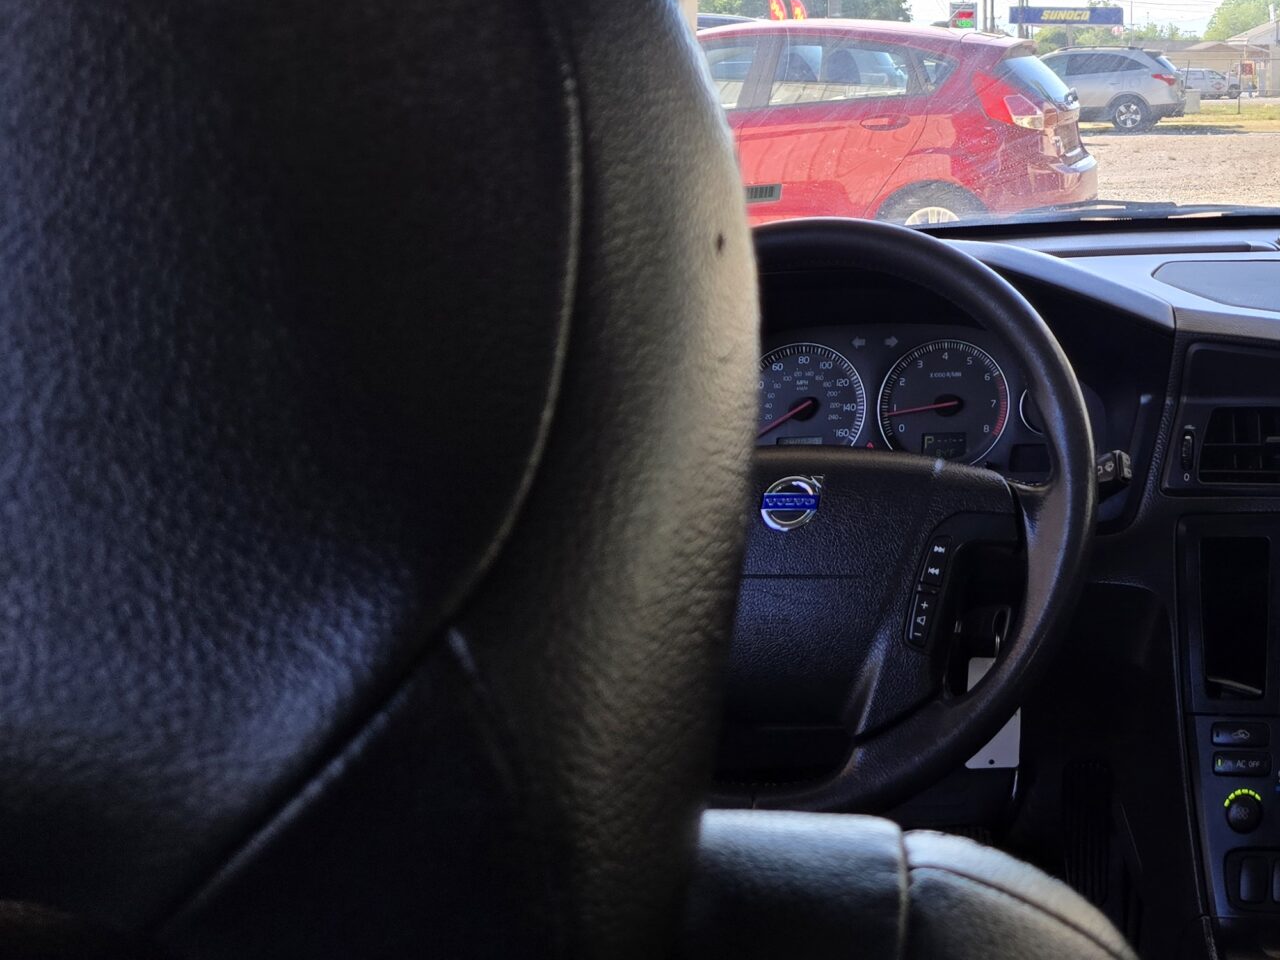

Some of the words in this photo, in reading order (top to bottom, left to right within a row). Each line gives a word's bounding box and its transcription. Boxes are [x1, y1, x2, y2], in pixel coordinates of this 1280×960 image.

[1040, 10, 1089, 20] SUNOCO
[798, 355, 810, 365] 80
[942, 352, 949, 361] 4
[820, 361, 833, 370] 100
[917, 360, 924, 369] 3
[967, 357, 973, 366] 5
[772, 362, 784, 371] 60
[899, 377, 906, 386] 2
[984, 373, 991, 381] 6
[836, 378, 849, 387] 120
[843, 404, 857, 412] 140
[991, 399, 997, 408] 7
[835, 428, 850, 437] 160
[765, 497, 816, 506] VOLVO
